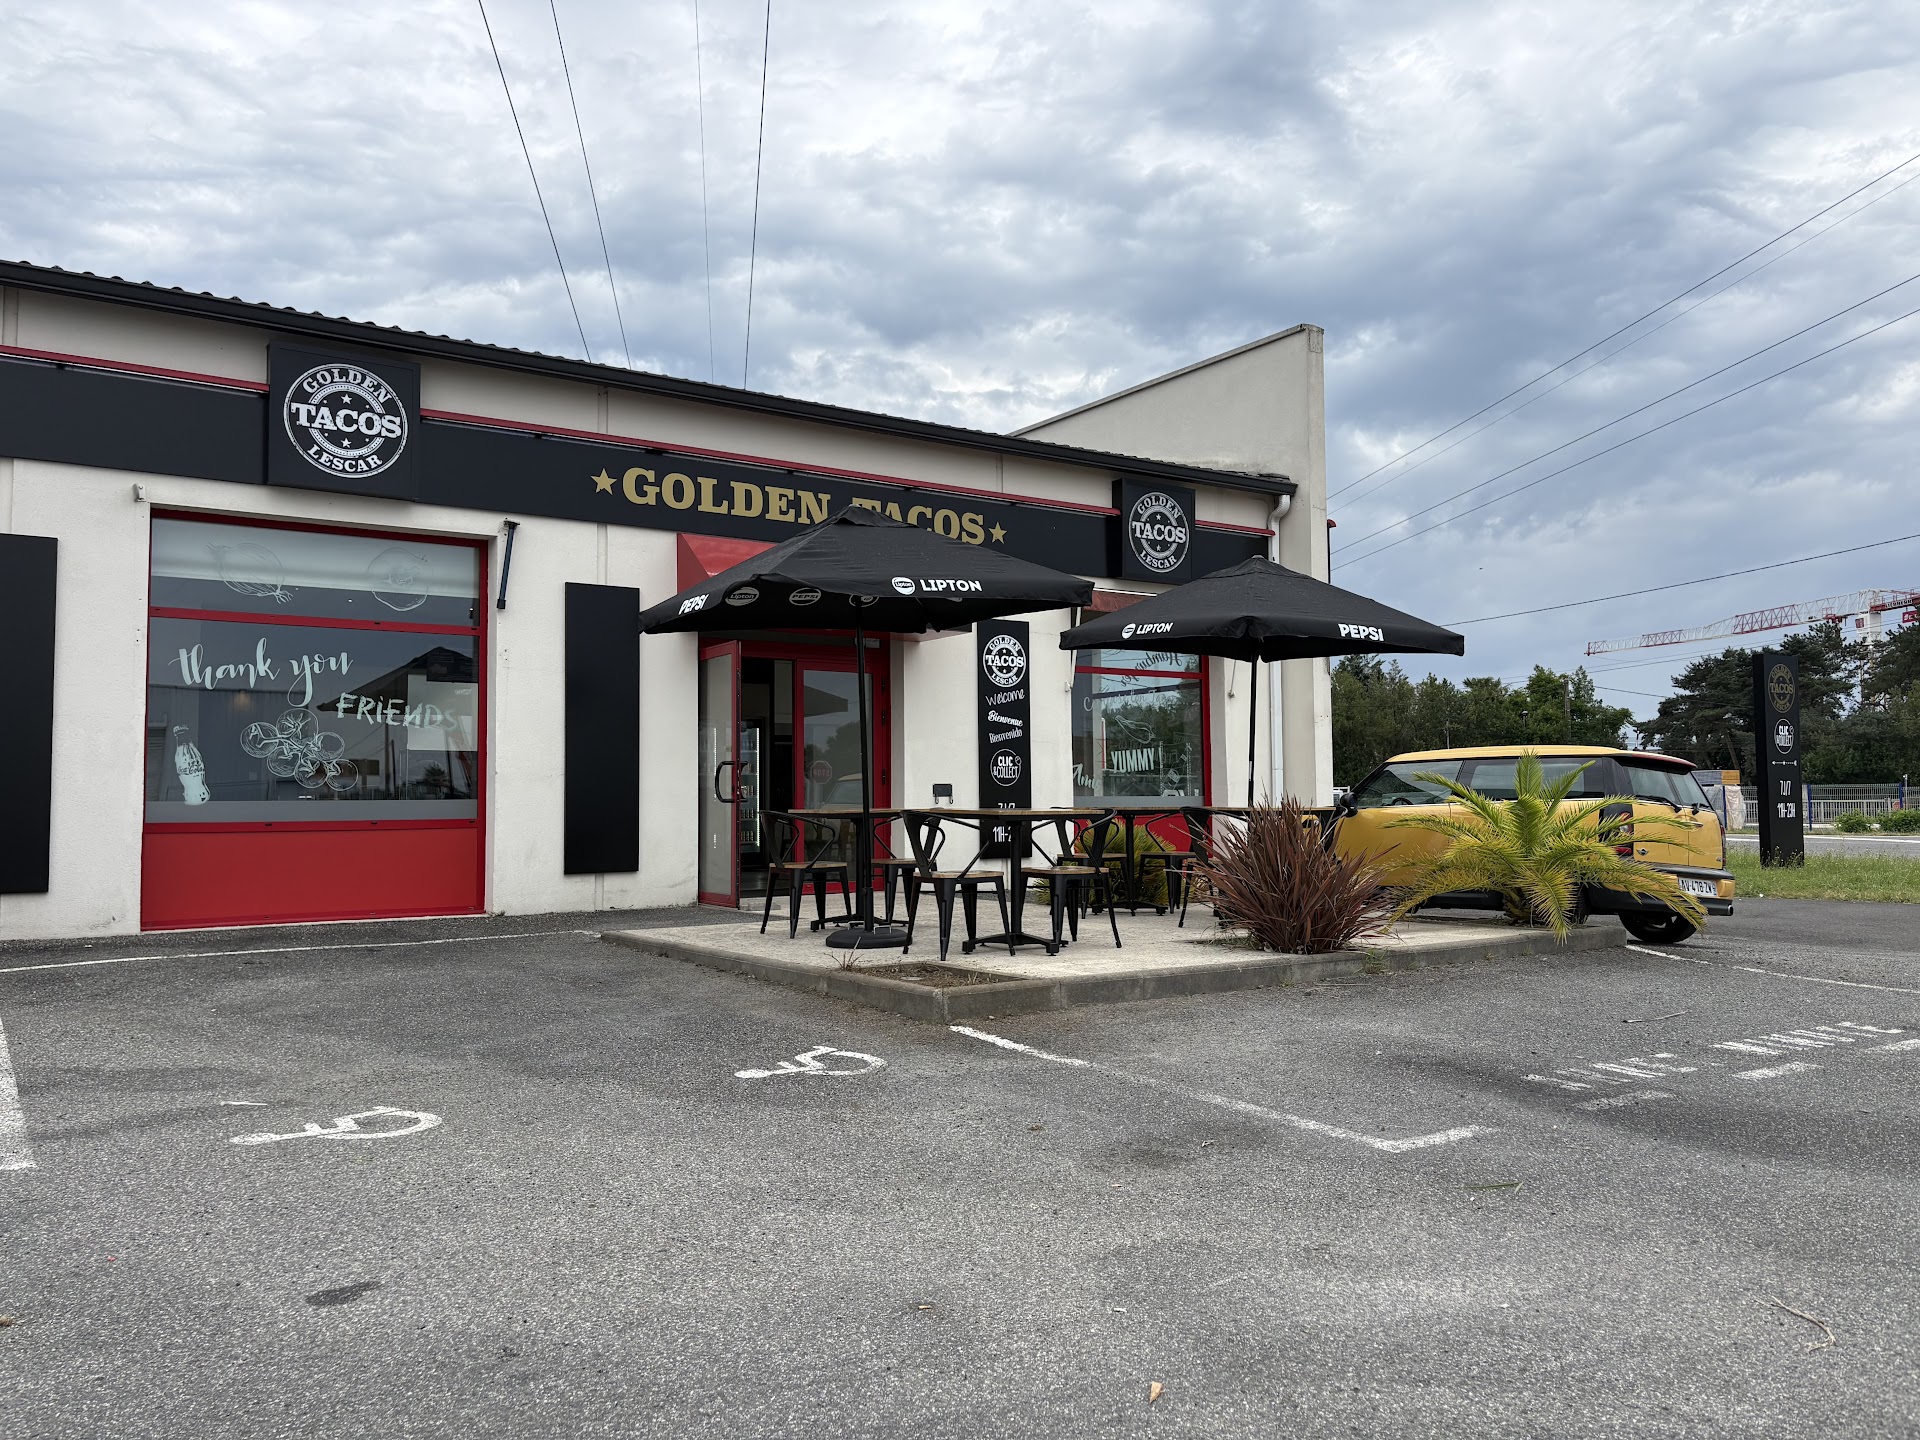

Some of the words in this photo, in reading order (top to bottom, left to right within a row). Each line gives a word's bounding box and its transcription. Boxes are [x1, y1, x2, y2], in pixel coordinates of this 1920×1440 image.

[302, 368, 392, 404] GOLDEN
[290, 402, 402, 438] TACOS
[307, 444, 383, 472] LESCAR
[622, 467, 831, 525] GOLDEN
[1137, 495, 1181, 519] GOLDEN
[1132, 521, 1187, 544] TACOS
[1140, 549, 1177, 568] LESCAR
[919, 579, 983, 592] LIPTON
[679, 594, 710, 615] PEPSI
[1136, 622, 1174, 635] LIPTON
[1338, 623, 1384, 642] PEPSI
[989, 637, 1021, 651] GOLDEN
[985, 654, 1024, 668] TACOS
[168, 638, 280, 690] thank
[287, 652, 354, 708] you
[991, 673, 1018, 685] LESCAR
[1770, 683, 1794, 694] TACOS
[987, 710, 1024, 727] Bienvenue
[998, 756, 1013, 767] CLIC
[1111, 748, 1155, 773] YUMMY
[1777, 803, 1796, 818] 11H-23H
